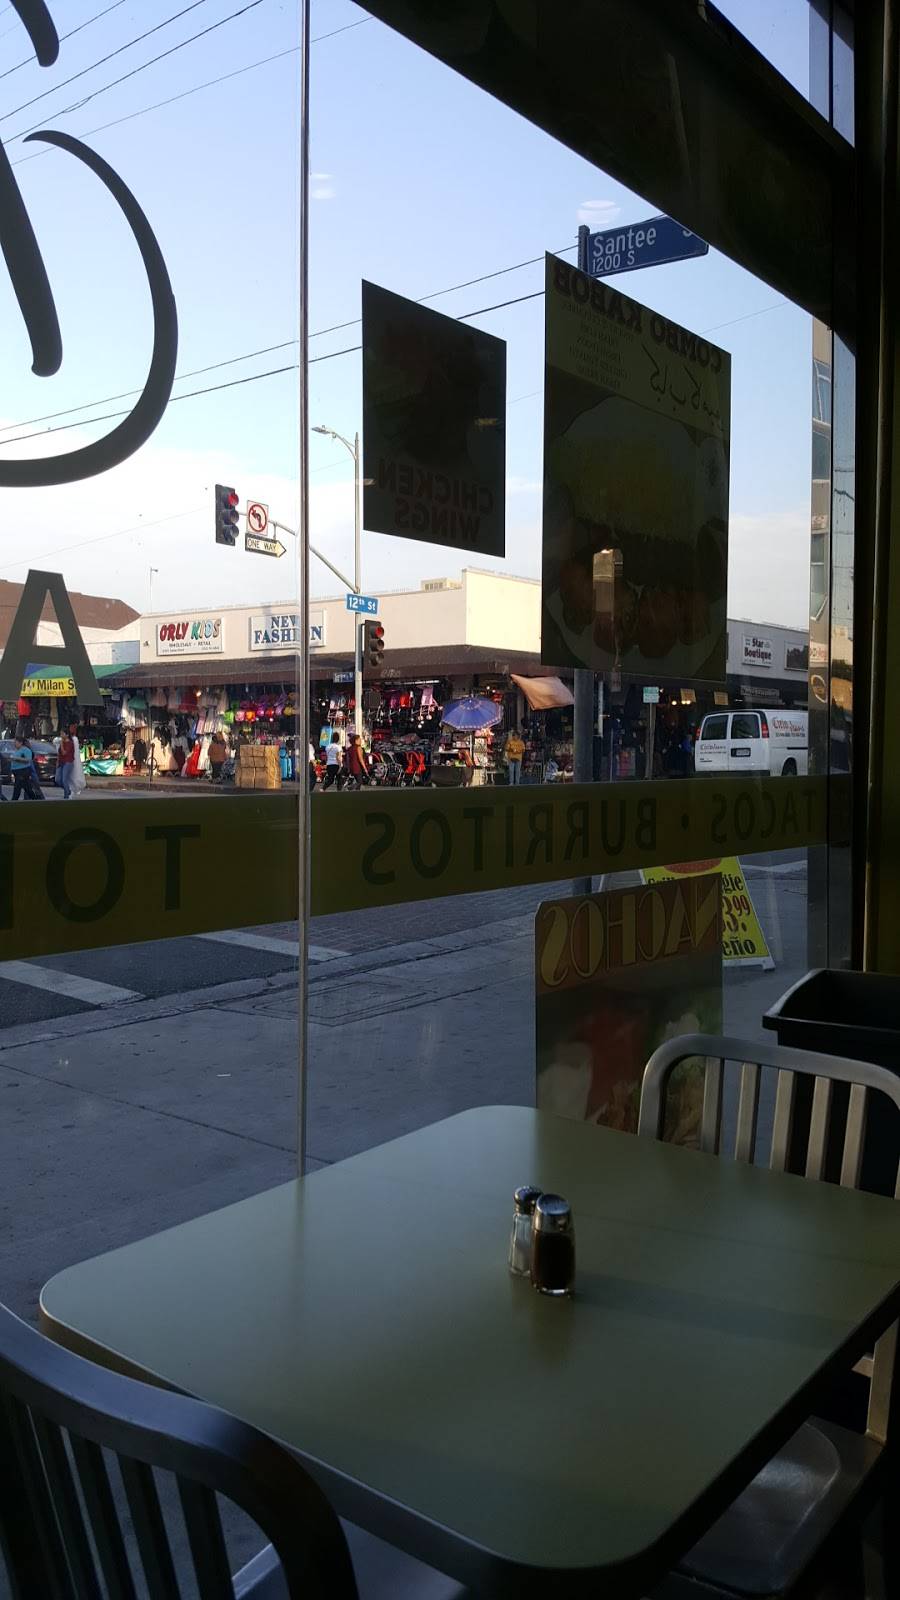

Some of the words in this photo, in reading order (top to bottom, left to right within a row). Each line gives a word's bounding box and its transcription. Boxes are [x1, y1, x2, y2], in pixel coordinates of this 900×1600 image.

[593, 227, 657, 258] Santee
[592, 253, 621, 273] 1200
[626, 250, 635, 266] S
[247, 538, 260, 549] ONE
[264, 541, 277, 551] WAY
[349, 597, 365, 609] 12th
[367, 601, 376, 611] St
[160, 622, 189, 641] ORLY
[191, 618, 222, 640] KIDS
[255, 625, 323, 645] FASHIN
[752, 638, 764, 648] Star
[744, 647, 772, 662] Boutique
[38, 679, 64, 691] Milan
